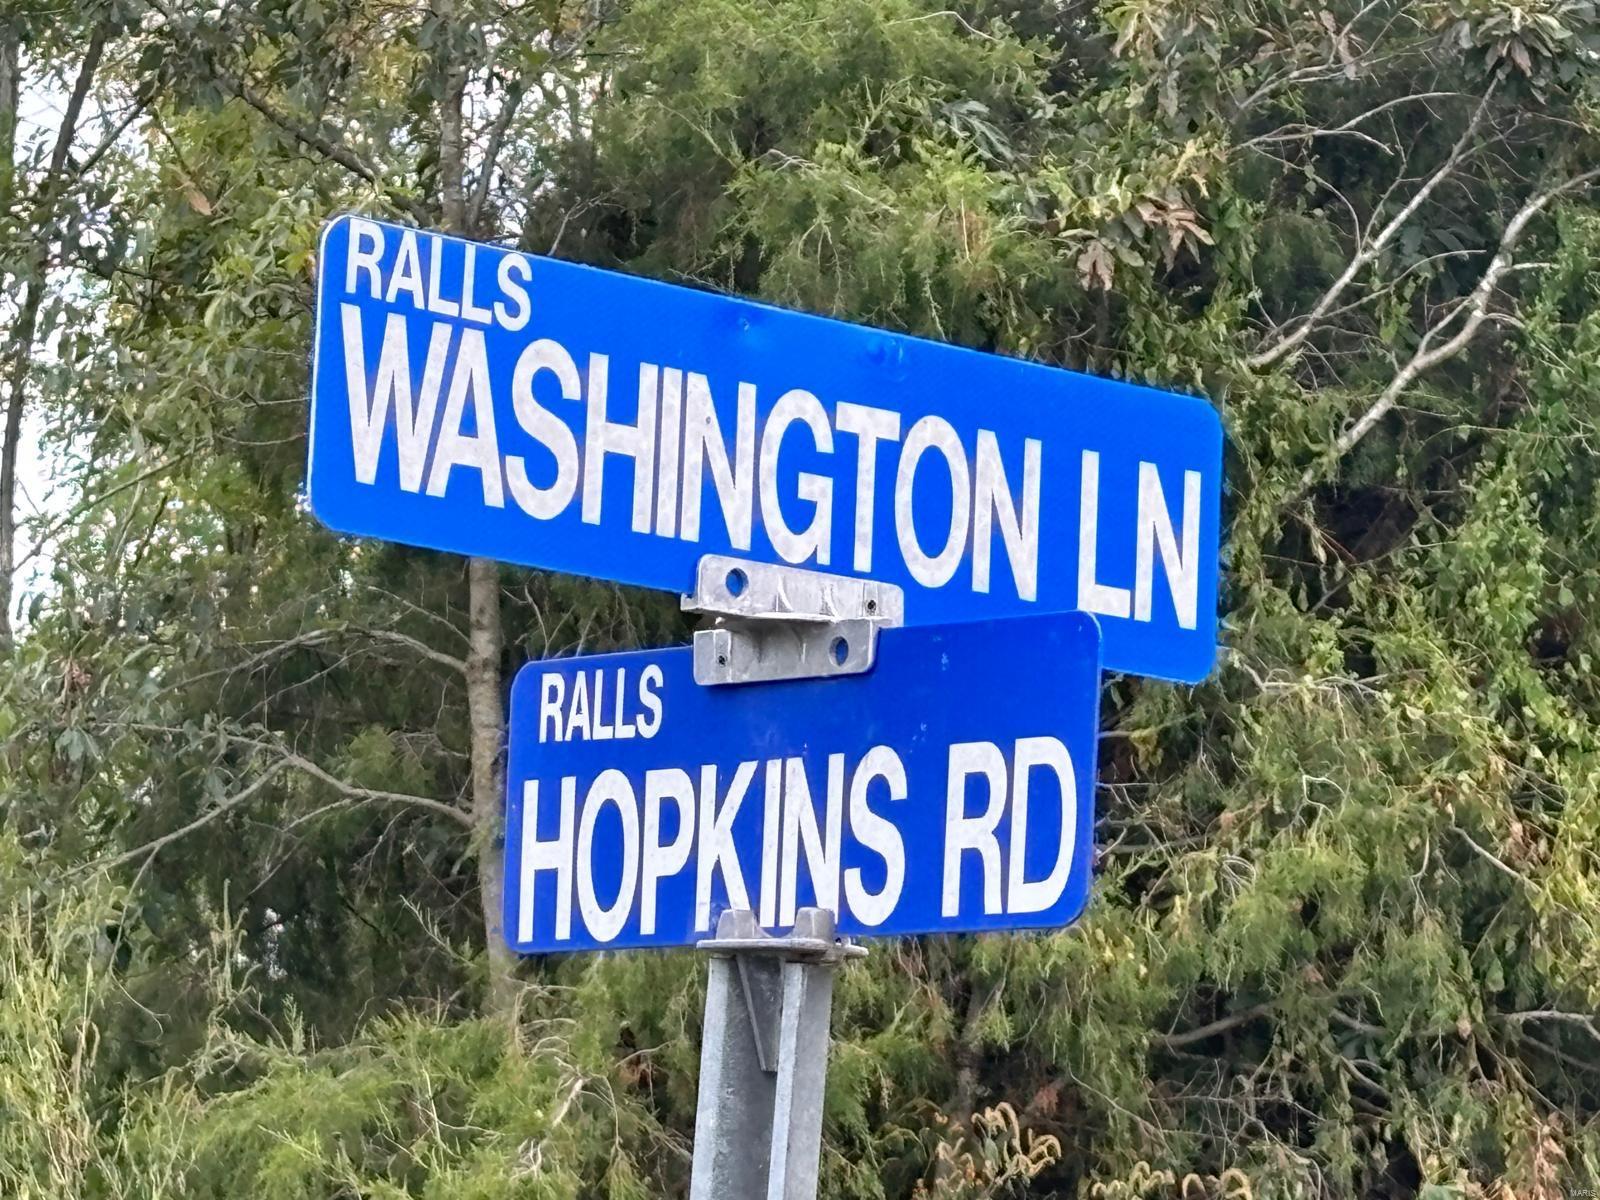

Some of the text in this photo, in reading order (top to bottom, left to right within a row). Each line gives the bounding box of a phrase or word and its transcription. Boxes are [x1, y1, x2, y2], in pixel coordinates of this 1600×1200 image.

[346, 219, 533, 332] RALLS
[340, 303, 1201, 629] WASHINGTON LN
[538, 664, 664, 743] RALLS
[518, 736, 1077, 943] HOPKINS RD
